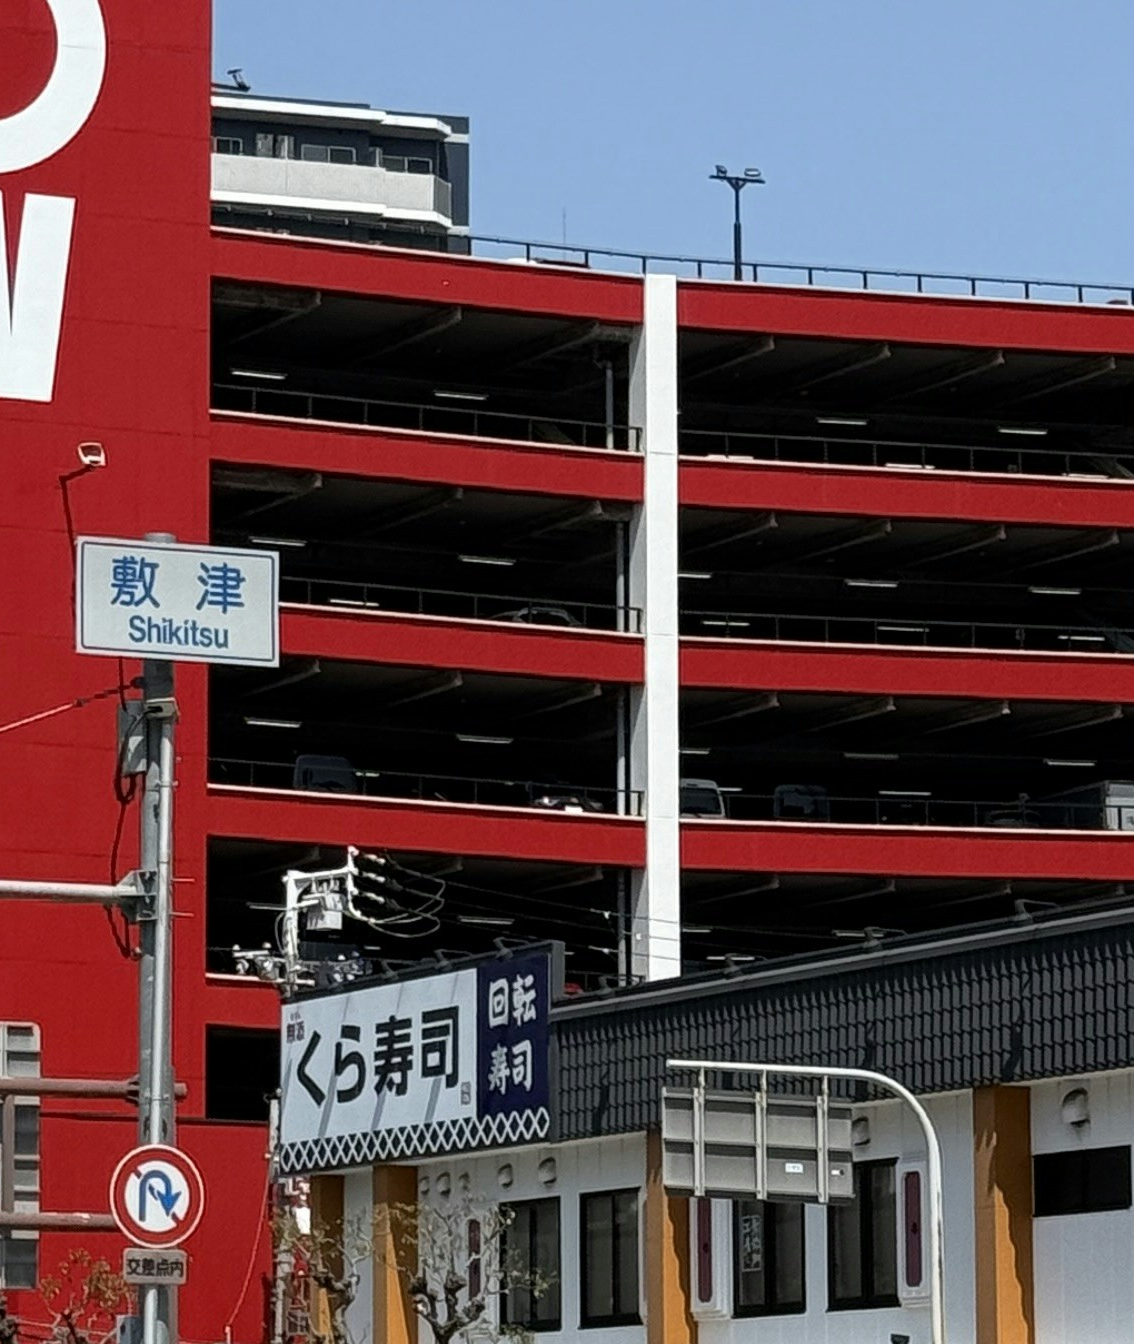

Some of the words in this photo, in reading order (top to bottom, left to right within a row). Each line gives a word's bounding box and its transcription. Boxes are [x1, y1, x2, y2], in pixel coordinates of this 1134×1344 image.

[110, 555, 247, 615] 敷津
[128, 615, 230, 649] Shikitsu
[488, 973, 537, 1030] 回転
[296, 1005, 460, 1108] くら寿司
[487, 1038, 533, 1096] 寿司
[126, 1257, 184, 1279] 交差点内
